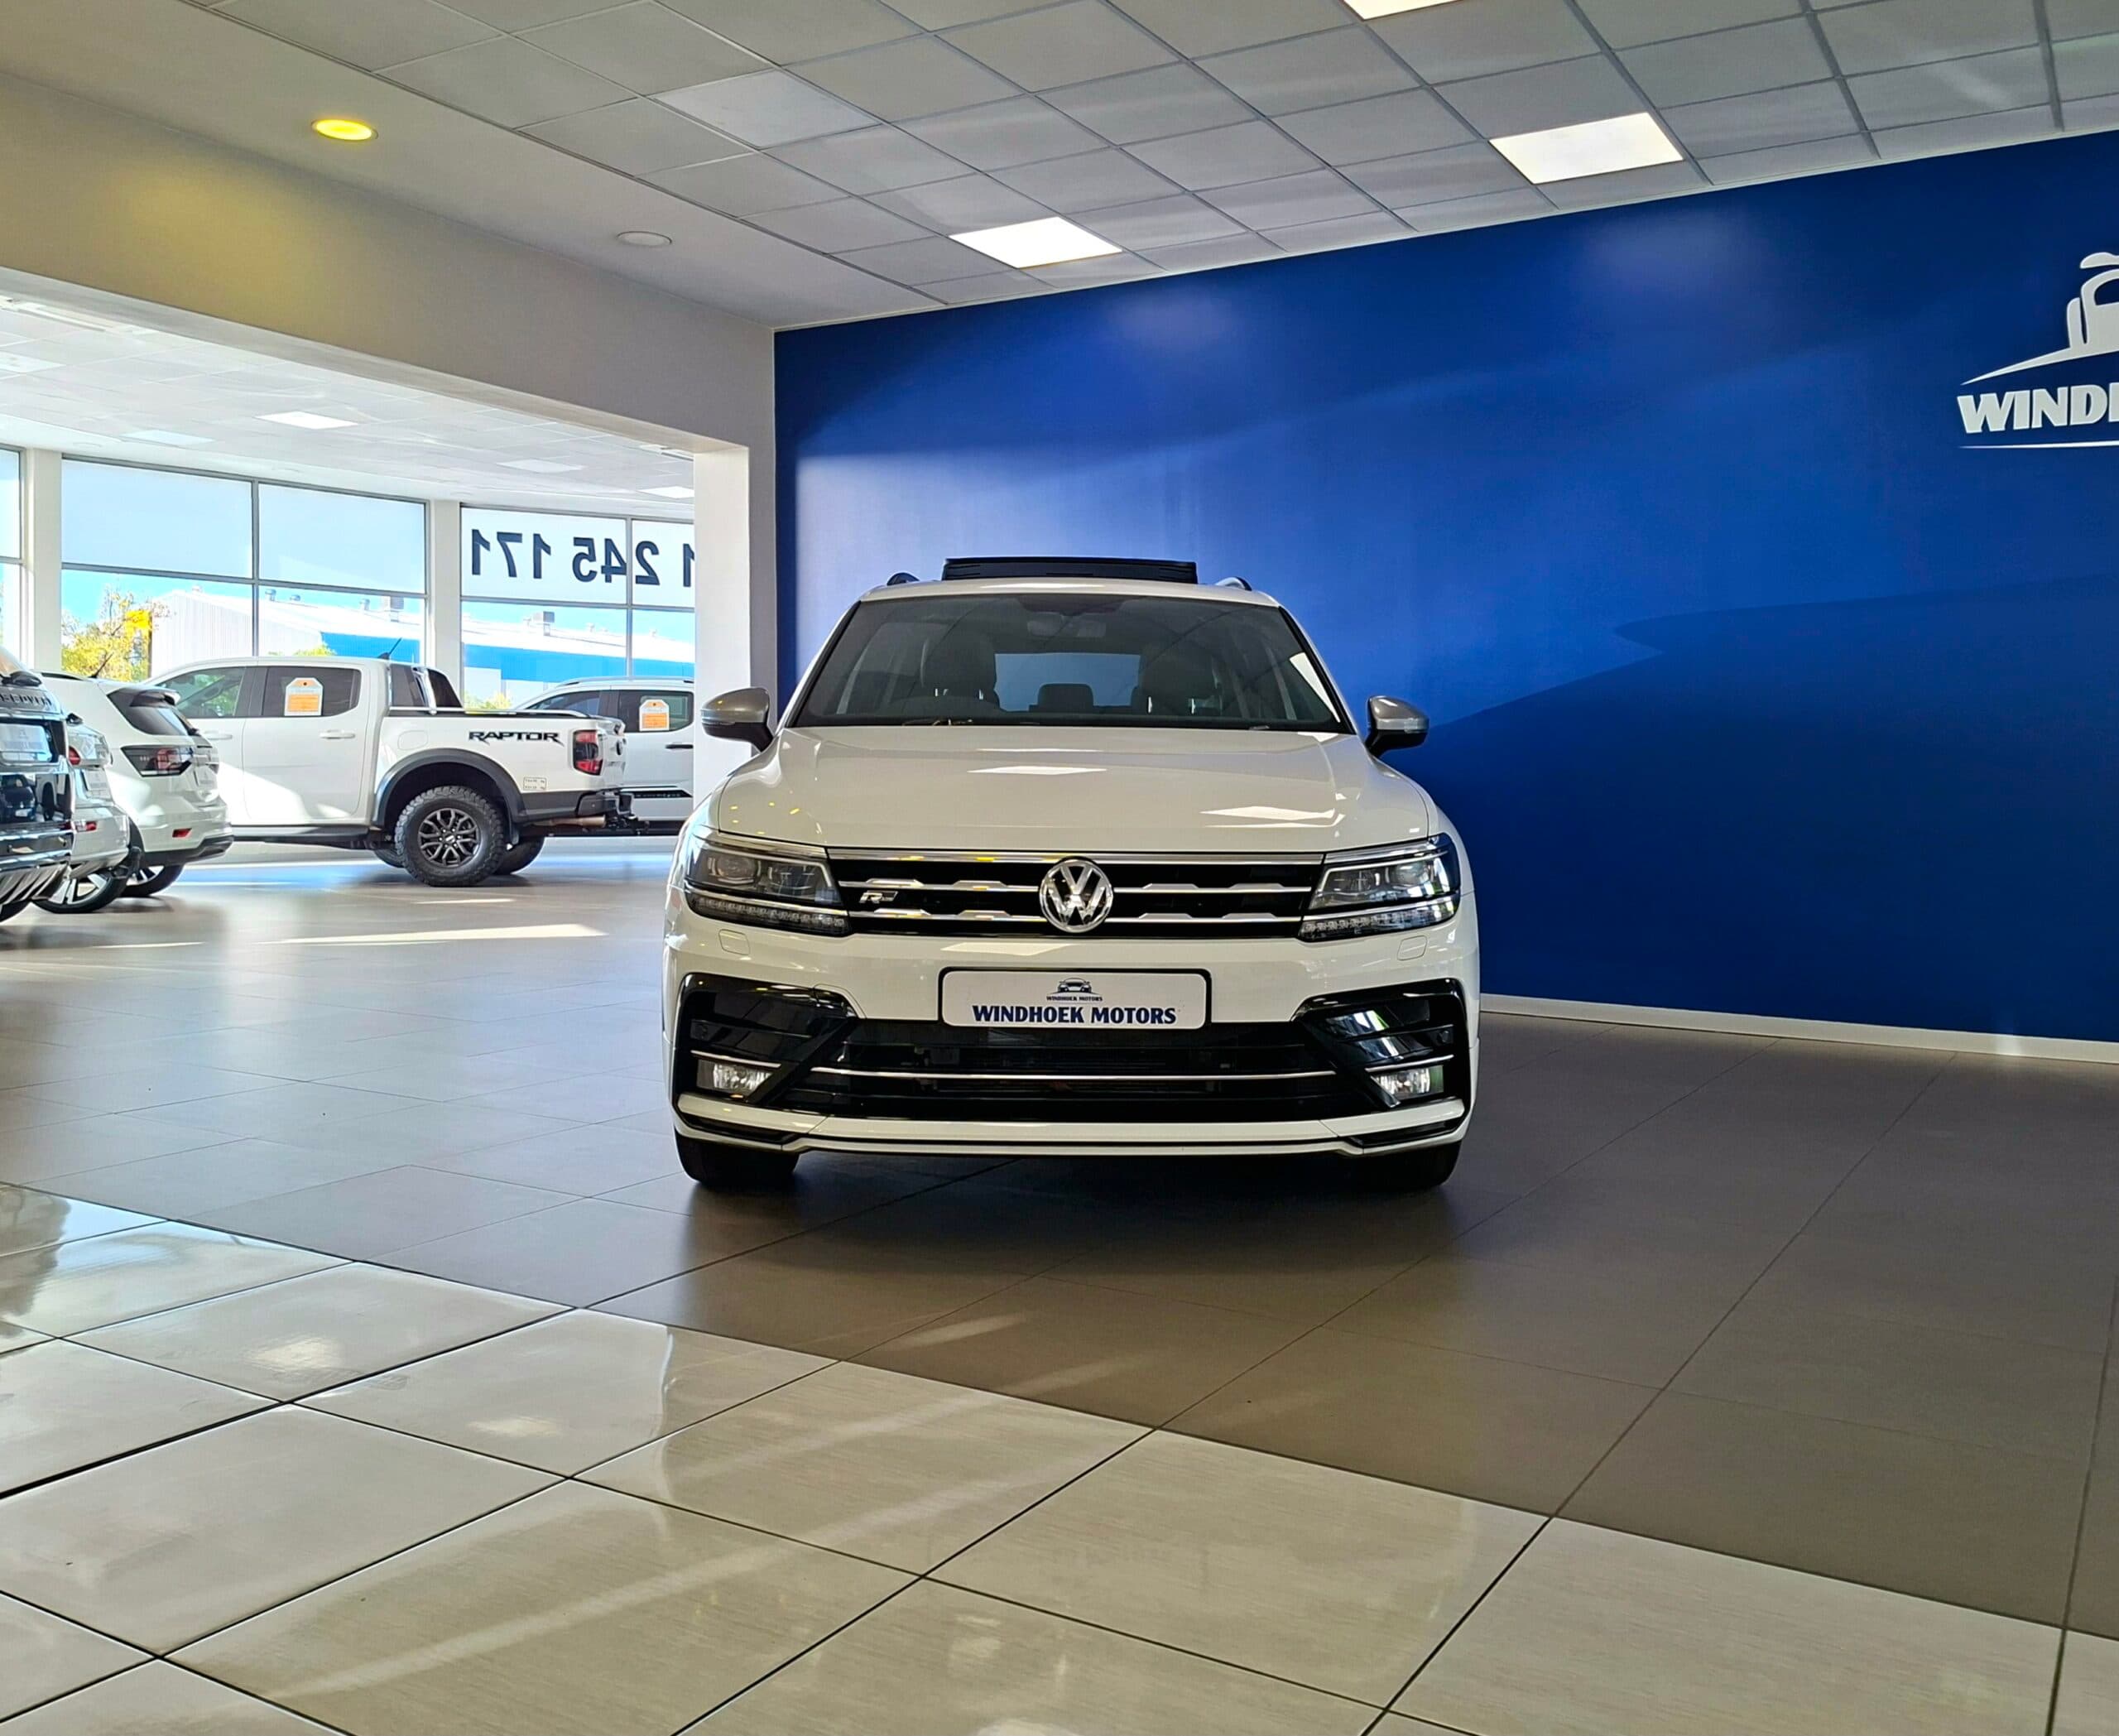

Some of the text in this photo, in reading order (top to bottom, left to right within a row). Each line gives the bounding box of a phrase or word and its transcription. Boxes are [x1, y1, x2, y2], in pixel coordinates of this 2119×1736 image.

[1957, 382, 2119, 434] WIND
[468, 731, 565, 747] RAPTOR
[972, 1005, 1176, 1024] WINDHOEK MOTORS
